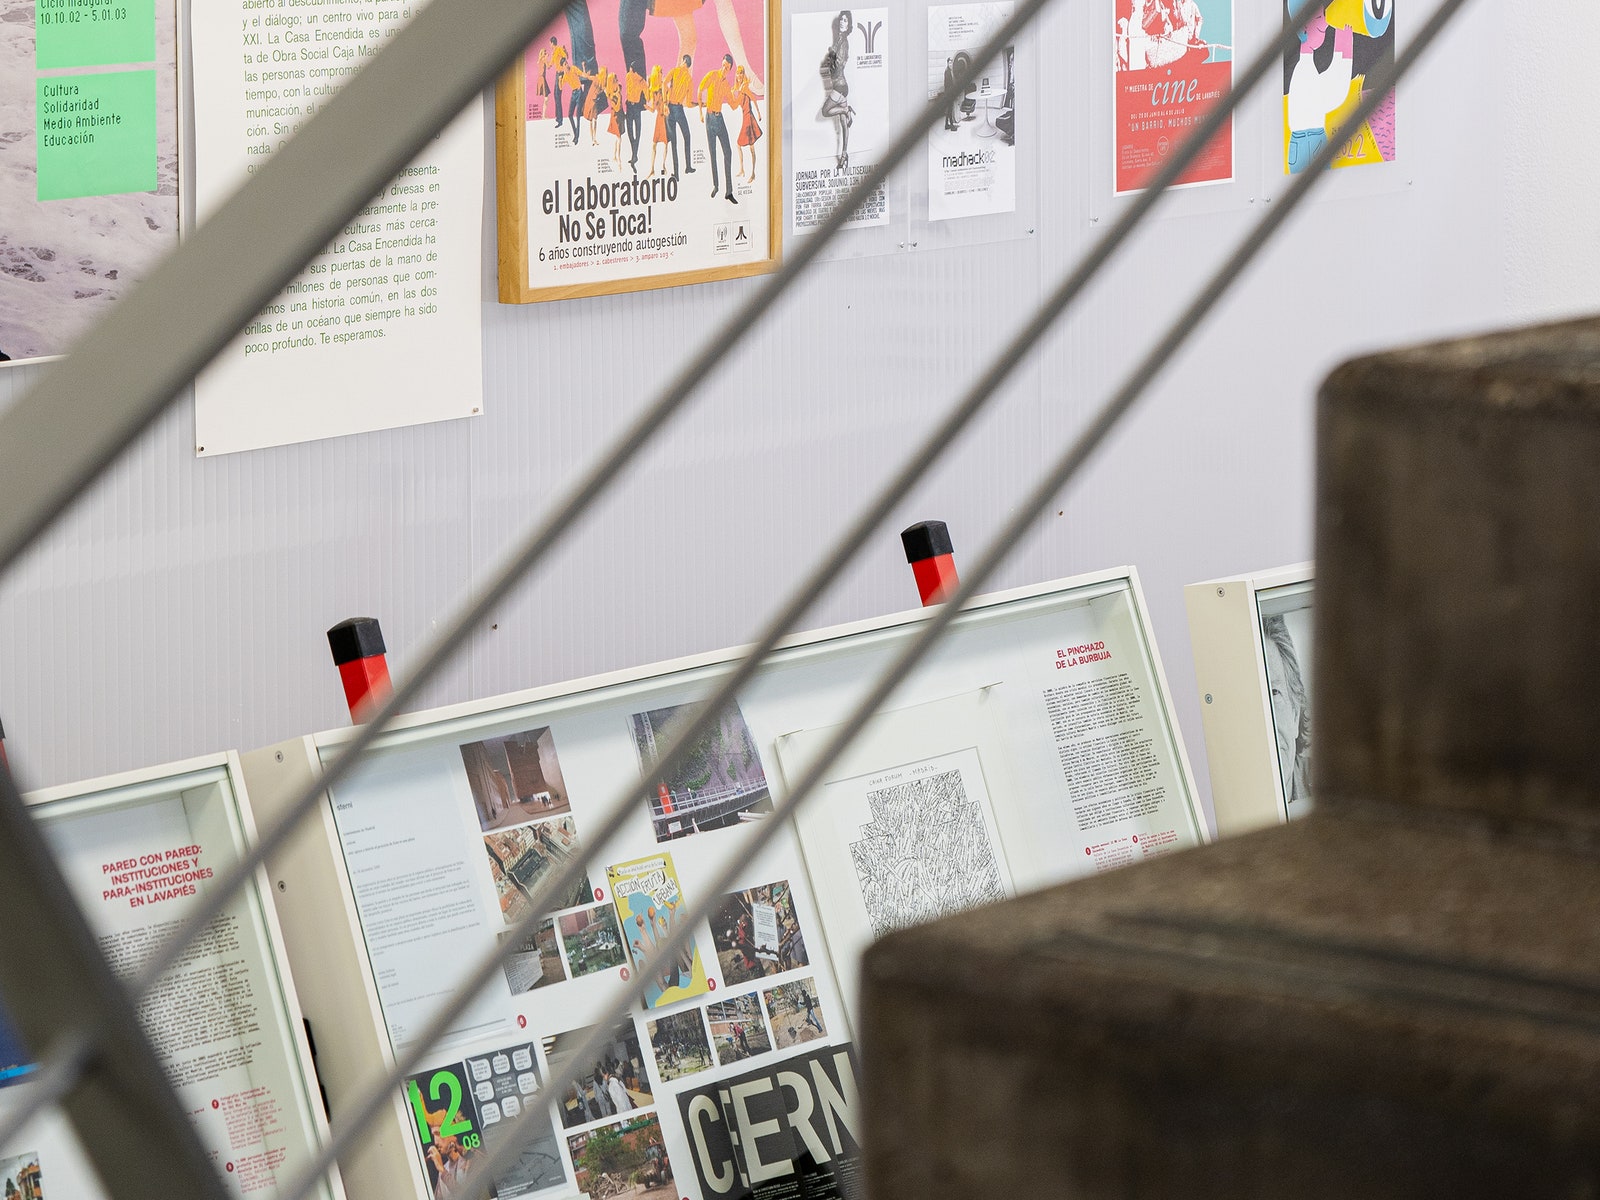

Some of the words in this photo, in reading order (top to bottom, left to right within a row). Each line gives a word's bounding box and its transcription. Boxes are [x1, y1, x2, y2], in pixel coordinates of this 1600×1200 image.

[40, 11, 81, 24] 10.10.02
[92, 8, 127, 22] 5.01.03
[43, 84, 79, 97] Cultura
[1129, 84, 1147, 92] MUESTRA
[1149, 83, 1153, 91] DE
[1152, 69, 1198, 106] cine
[43, 98, 99, 114] Solidaridad
[43, 117, 72, 130] Medio
[76, 113, 121, 128] Ambiente
[44, 131, 94, 147] Educación
[796, 170, 817, 181] JORNADA
[820, 169, 831, 178] POR
[834, 168, 839, 177] LA
[542, 180, 559, 215] el
[568, 176, 678, 212] laboratorio
[559, 214, 581, 243] No
[586, 211, 605, 240] Se
[609, 206, 652, 237] Toca!
[539, 247, 545, 261] 6
[549, 246, 569, 261] años
[573, 239, 633, 257] construyendo
[636, 232, 687, 251] autogestión
[291, 302, 307, 313] una
[312, 296, 345, 309] historia
[350, 292, 383, 306] común,
[388, 291, 399, 301] en
[404, 288, 416, 299] las
[421, 285, 437, 297] dos
[244, 323, 272, 336] orillas
[276, 320, 287, 332] de
[292, 319, 303, 330] un
[307, 314, 340, 328] océano
[344, 313, 361, 326] que
[365, 309, 401, 322] siempre
[405, 305, 415, 317] ha
[419, 302, 437, 315] sido
[245, 342, 269, 356] poco
[272, 337, 316, 353] profundo.
[320, 332, 330, 344] Te
[333, 328, 386, 343] esperamos.
[1056, 660, 1066, 669] DE
[1068, 658, 1078, 667] LA
[1079, 651, 1112, 665] BURBUJA
[1057, 649, 1066, 658] EL
[1068, 641, 1105, 656] PINCHAZO
[102, 859, 137, 874] PARED
[140, 853, 162, 866] CON
[165, 845, 202, 860] PARED:
[111, 860, 190, 885] INSTITUCIONES
[192, 858, 198, 867] Y
[103, 868, 213, 901] PARA-INSTITUCIONES
[130, 896, 144, 908] EN
[147, 885, 196, 904] LAVAPIÉS
[408, 1071, 473, 1144] 12
[462, 1133, 481, 1150] 08
